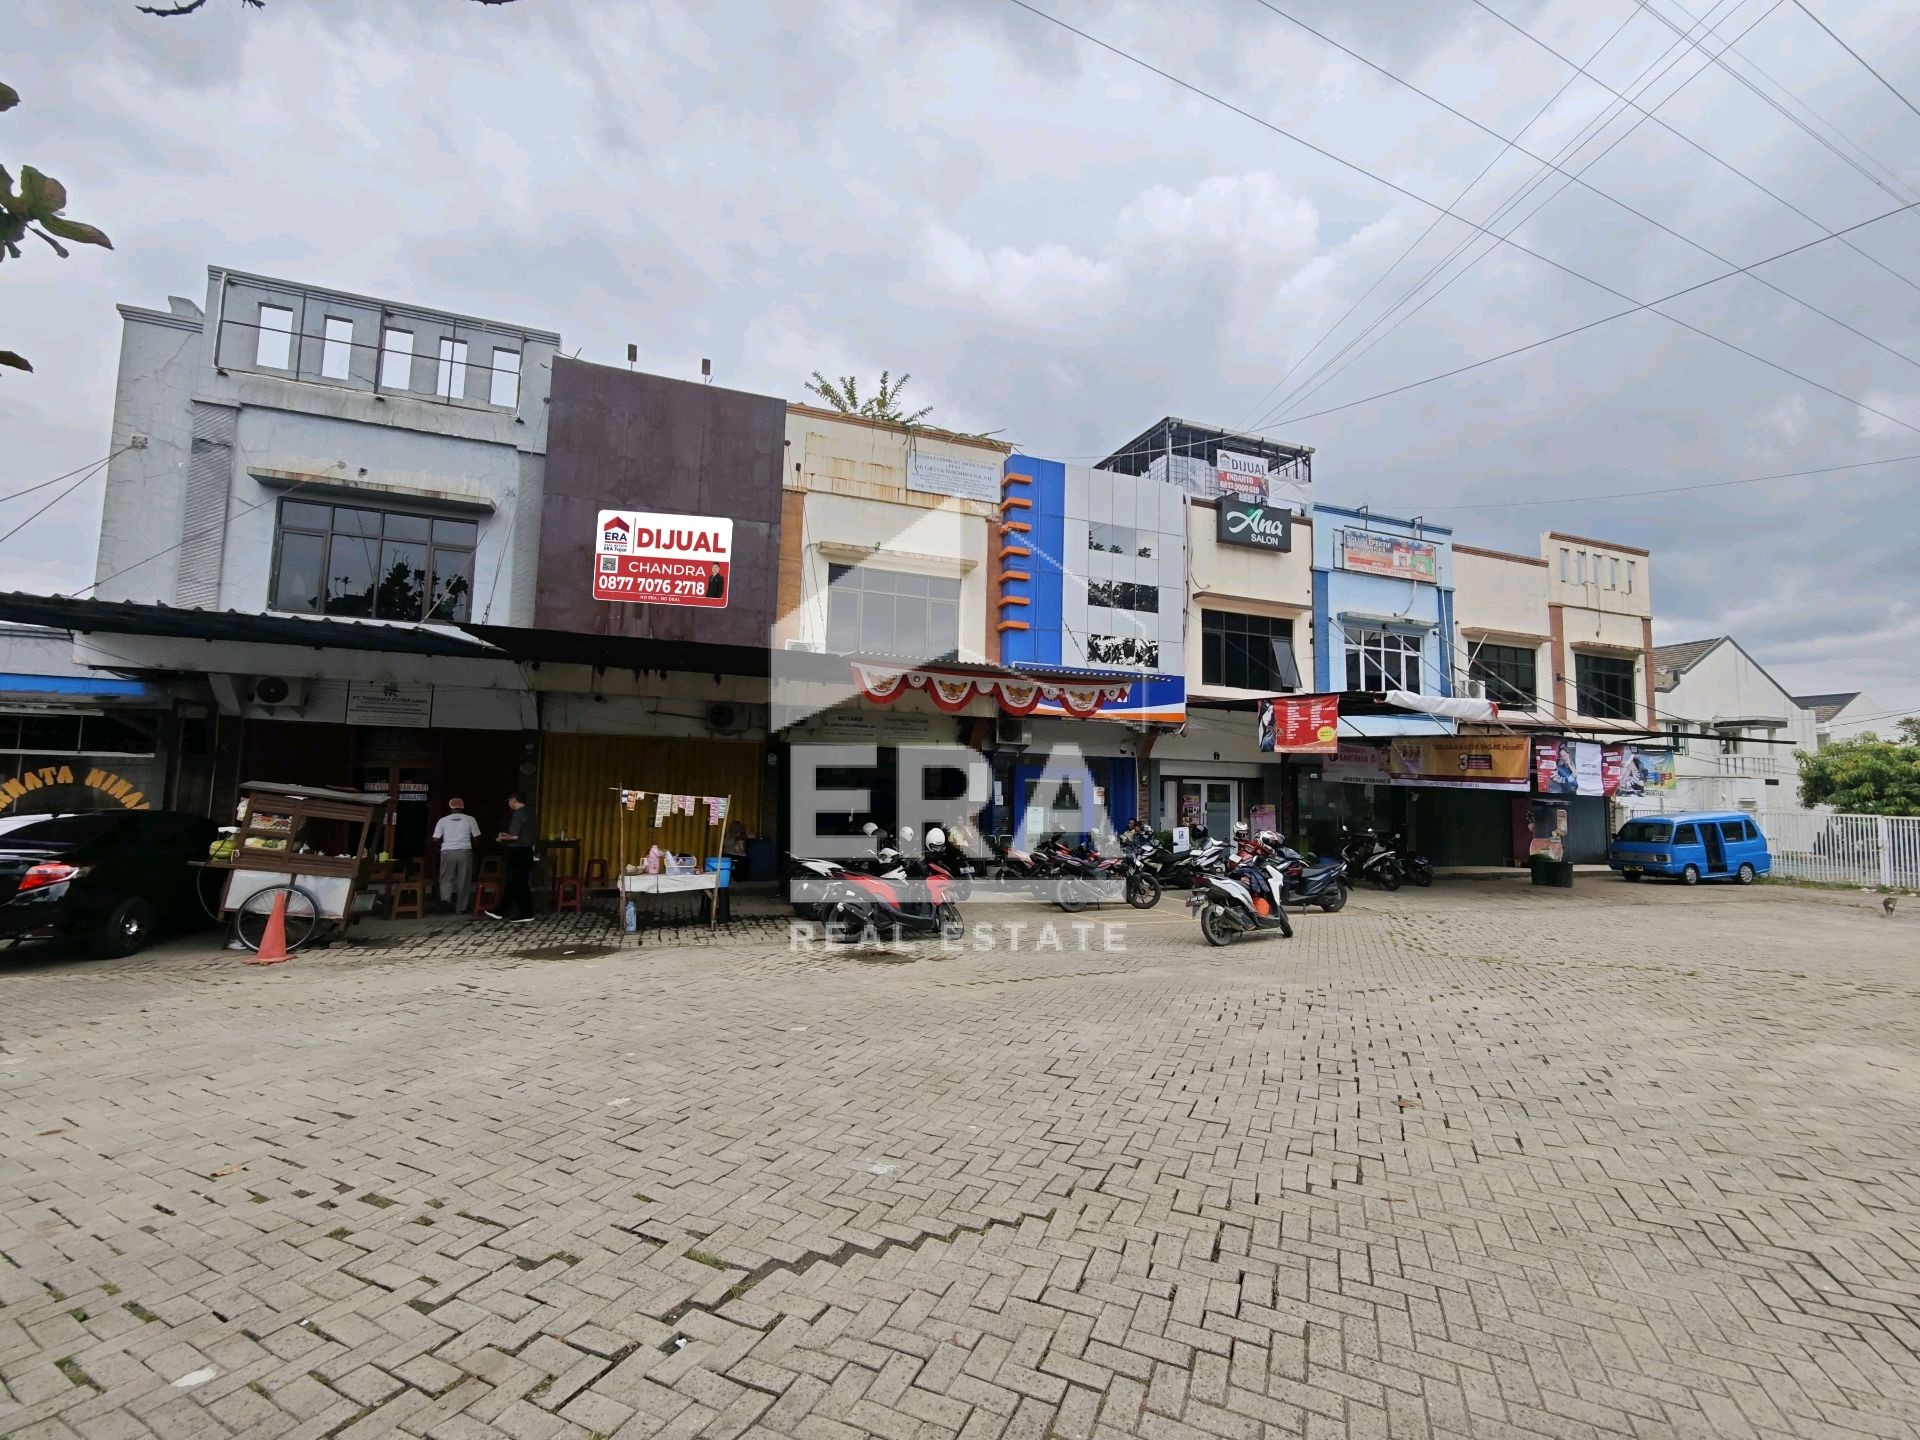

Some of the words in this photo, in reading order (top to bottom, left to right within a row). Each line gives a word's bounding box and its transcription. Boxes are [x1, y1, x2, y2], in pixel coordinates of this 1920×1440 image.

[1231, 459, 1267, 476] DIJUAL
[1226, 473, 1254, 485] INDARTO
[1227, 509, 1283, 537] Ana
[604, 532, 627, 542] ERA
[636, 527, 727, 553] DIJUAL
[1251, 533, 1279, 546] SALON
[628, 561, 706, 577] CHANDRA
[598, 575, 633, 591] 0877
[637, 577, 671, 593] 7076
[674, 580, 705, 596] 2718
[1458, 753, 1468, 770] 3
